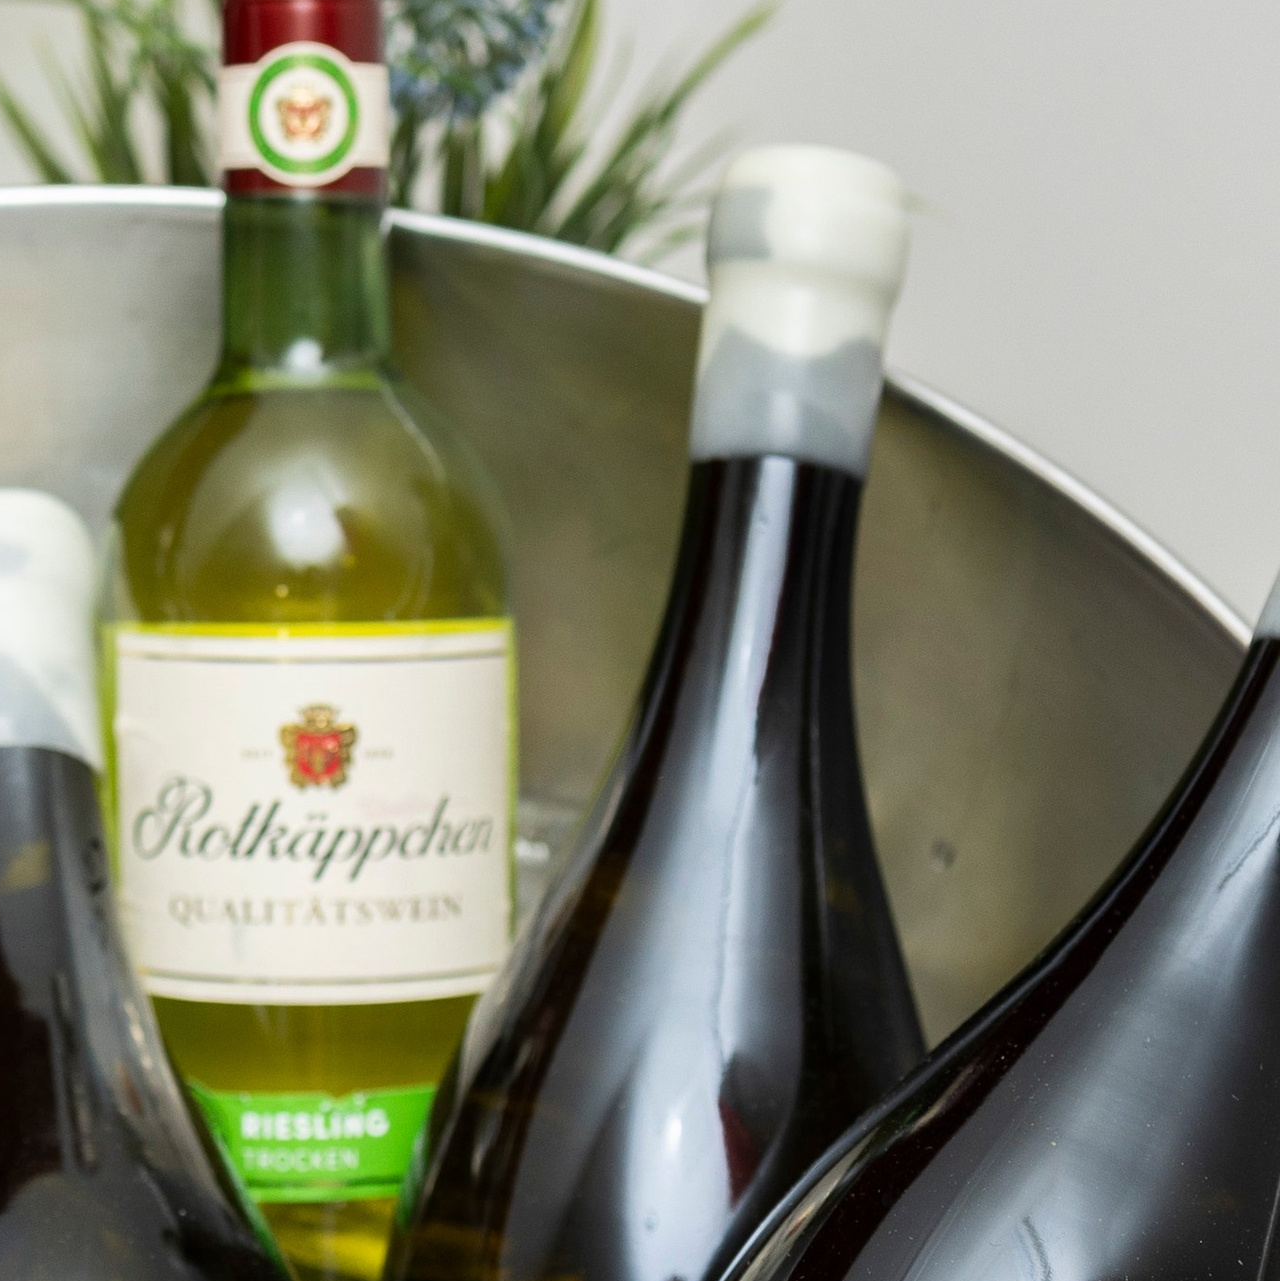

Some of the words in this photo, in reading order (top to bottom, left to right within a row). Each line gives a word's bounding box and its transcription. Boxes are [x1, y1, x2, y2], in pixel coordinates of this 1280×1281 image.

[132, 775, 496, 882] Rotkäppchen
[168, 893, 463, 926] QUALITÄTSWEIN
[240, 1108, 390, 1141] RIESLING
[241, 1147, 360, 1172] TROCKEN
